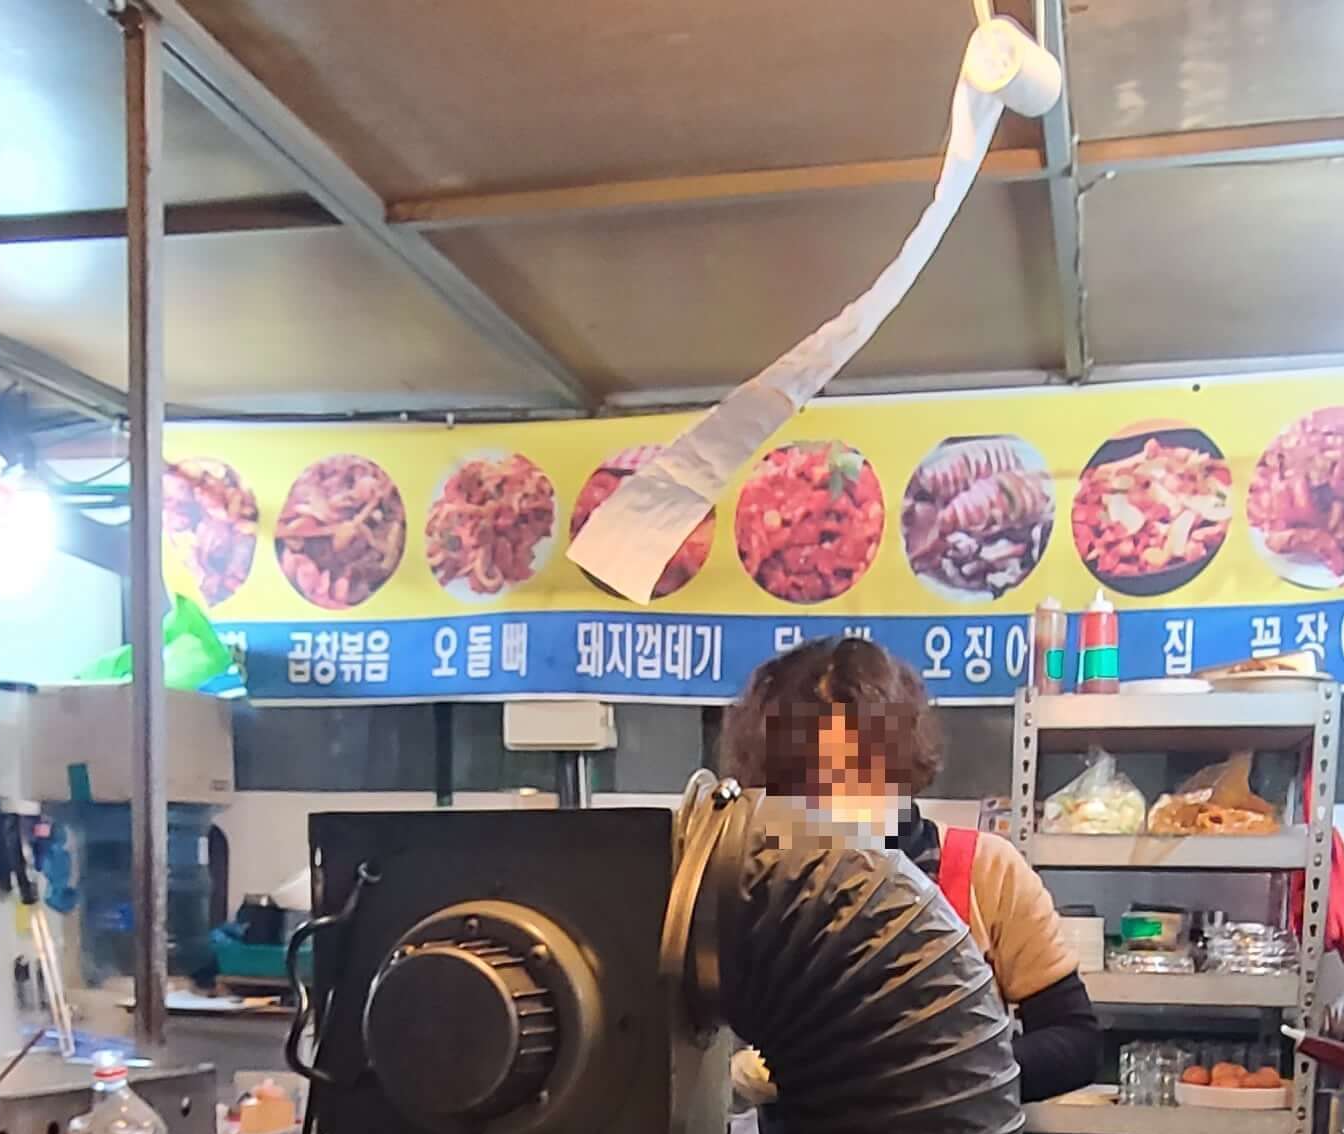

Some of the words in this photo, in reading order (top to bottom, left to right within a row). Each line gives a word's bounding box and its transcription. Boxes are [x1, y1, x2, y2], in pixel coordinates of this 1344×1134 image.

[287, 629, 391, 685] 곱창볶음
[431, 622, 529, 678] 오돌뼈
[575, 621, 723, 682] 돼지껍데기
